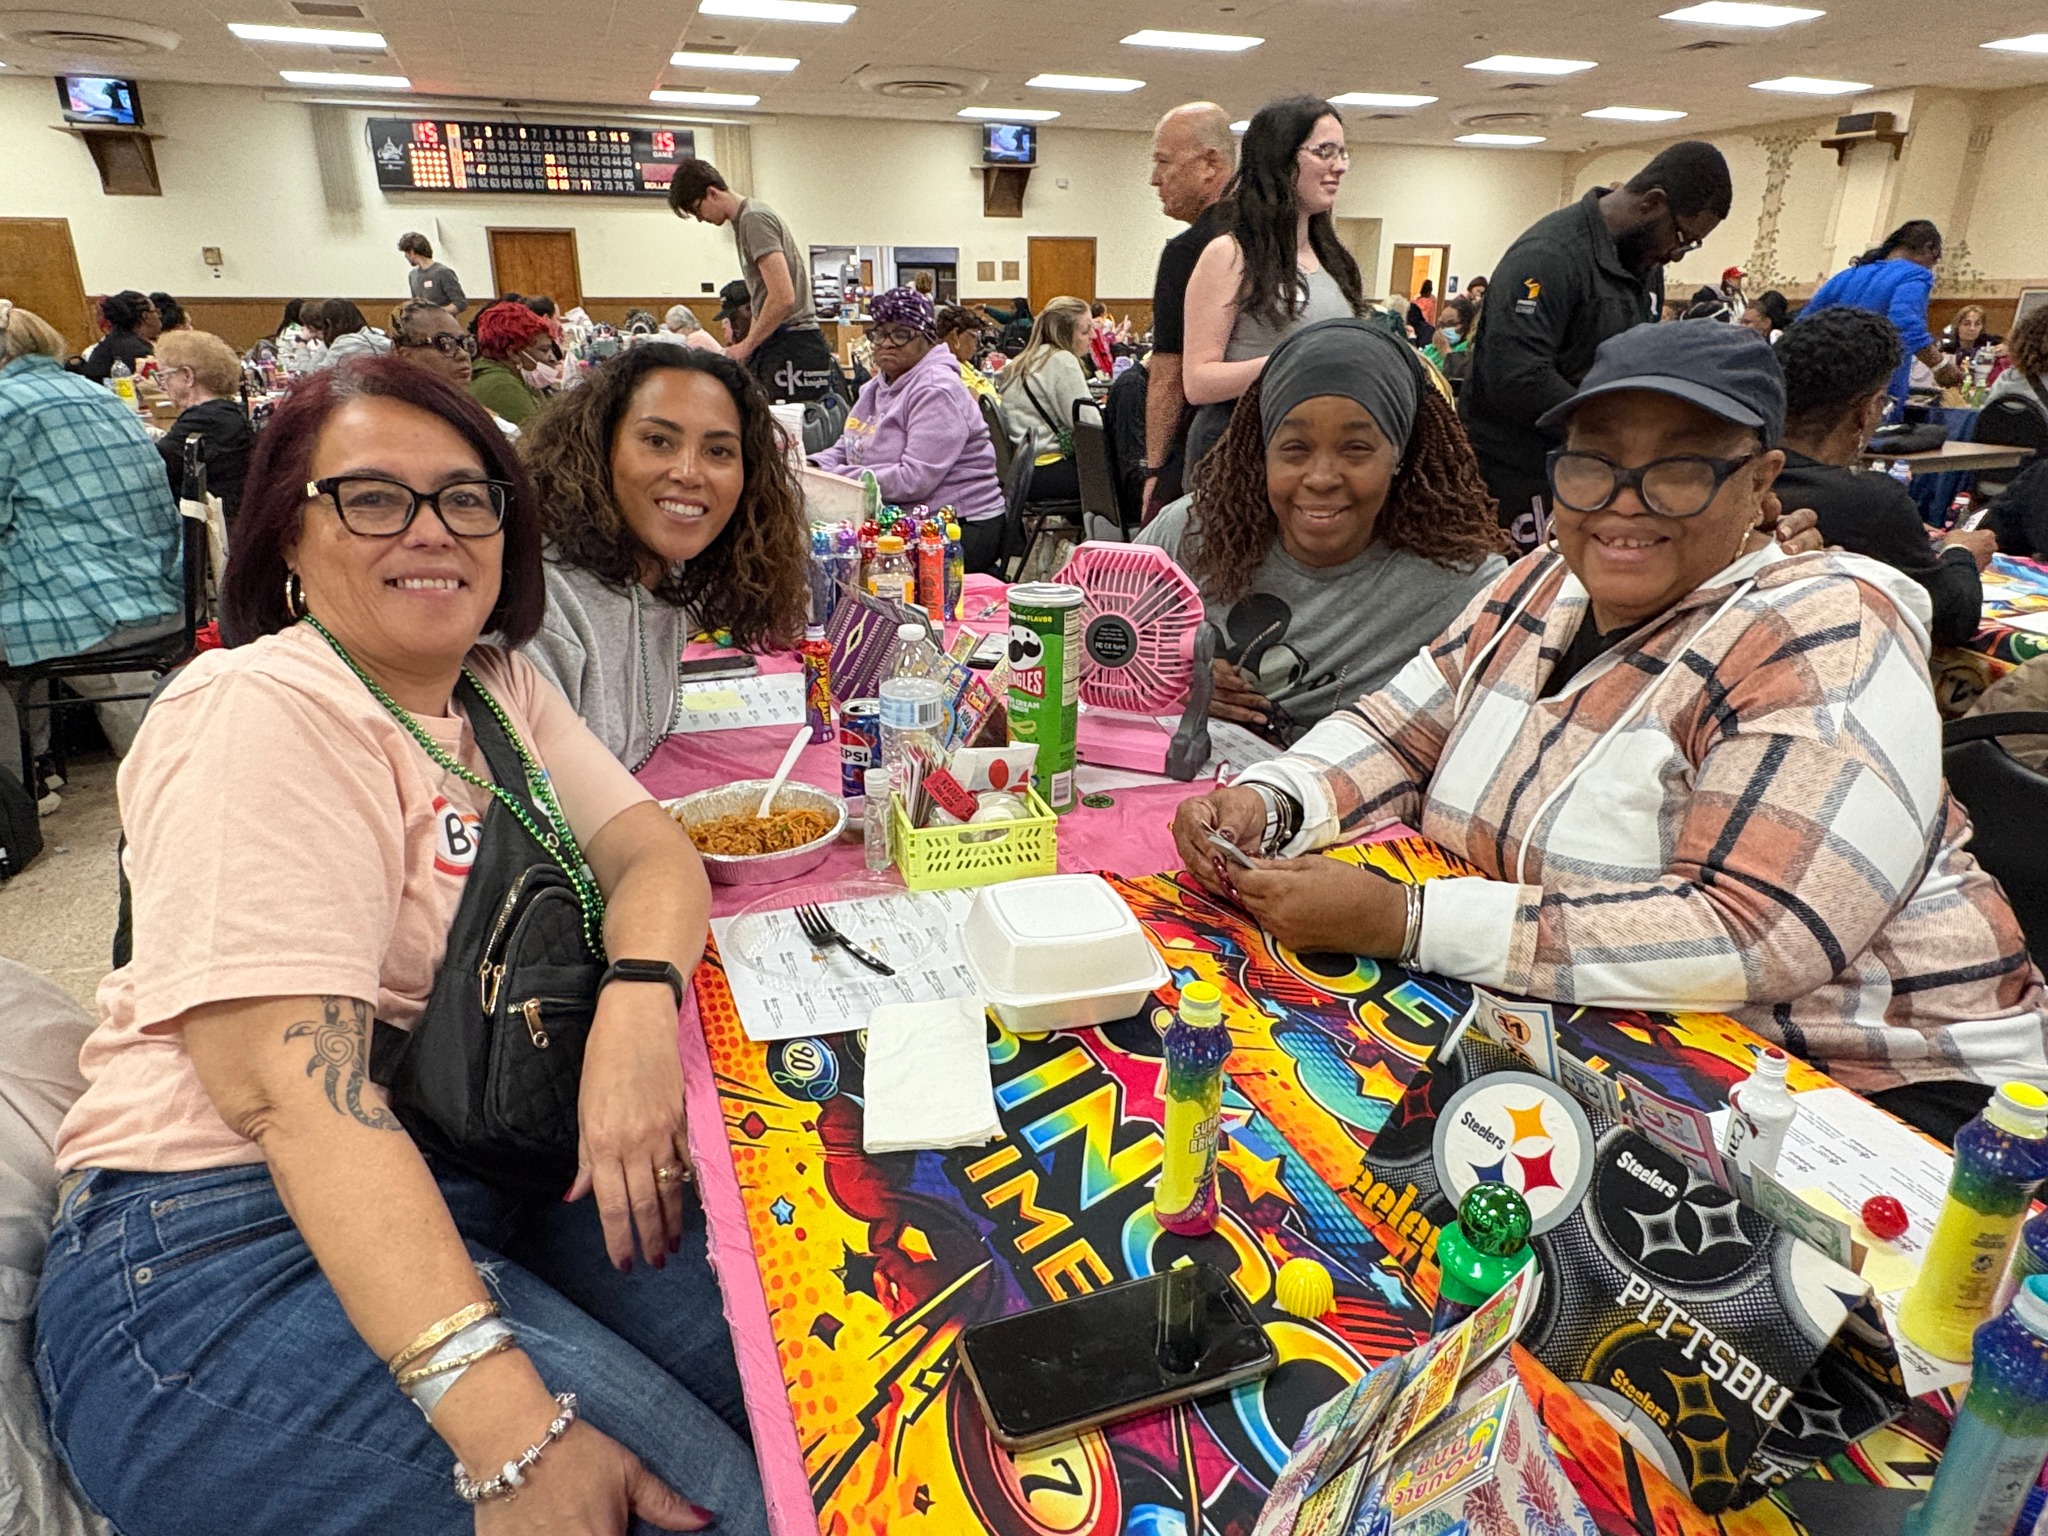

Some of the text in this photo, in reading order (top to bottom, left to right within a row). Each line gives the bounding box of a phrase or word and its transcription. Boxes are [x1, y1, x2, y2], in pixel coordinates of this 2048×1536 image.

[463, 126, 468, 136] 1
[474, 126, 480, 137] 2
[497, 127, 503, 137] 4
[508, 127, 515, 138] 5
[531, 128, 537, 138] 7
[544, 129, 550, 139] 8
[555, 129, 561, 139] 9
[565, 130, 574, 139] 10
[577, 131, 585, 139] 11
[600, 131, 607, 140] 13
[486, 140, 495, 150] 18
[497, 140, 506, 150] 19
[508, 141, 518, 151] 20
[520, 141, 529, 151] 21
[531, 141, 540, 151] 22
[543, 142, 553, 151] 23
[555, 142, 565, 152] 24
[566, 143, 576, 152] 25
[588, 144, 598, 153] 27
[610, 144, 620, 154] 29
[621, 145, 631, 154] 30
[463, 151, 474, 162] 31
[475, 152, 485, 162] 32
[486, 152, 497, 162] 33
[498, 152, 508, 162] 34
[509, 153, 520, 163] 35
[532, 154, 541, 164] 37
[579, 156, 589, 165] 41
[590, 156, 600, 166] 42
[601, 156, 611, 166] 43
[612, 157, 621, 166] 44
[622, 157, 632, 167] 45
[489, 165, 498, 175] 48
[511, 166, 521, 176] 50
[523, 166, 532, 176] 51
[534, 167, 543, 176] 52
[569, 168, 579, 177] 55
[591, 168, 600, 178] 57
[468, 177, 476, 188] 61
[478, 178, 489, 188] 62
[489, 178, 500, 188] 63
[501, 178, 511, 188] 64
[535, 179, 544, 189] 67
[571, 180, 580, 189] 70
[581, 179, 591, 190] 71
[592, 180, 602, 190] 72
[603, 181, 613, 190] 73
[614, 181, 623, 190] 74
[624, 181, 635, 191] 75
[1027, 615, 1053, 623] FLAVOR
[818, 678, 830, 701] BINGO
[1460, 1110, 1507, 1151] Steelers
[1616, 1150, 1678, 1199] Steelers
[1615, 1272, 1794, 1421] PITTSBU
[1609, 1367, 1671, 1429] Steelers
[1393, 1439, 1486, 1507] DOUBLE
